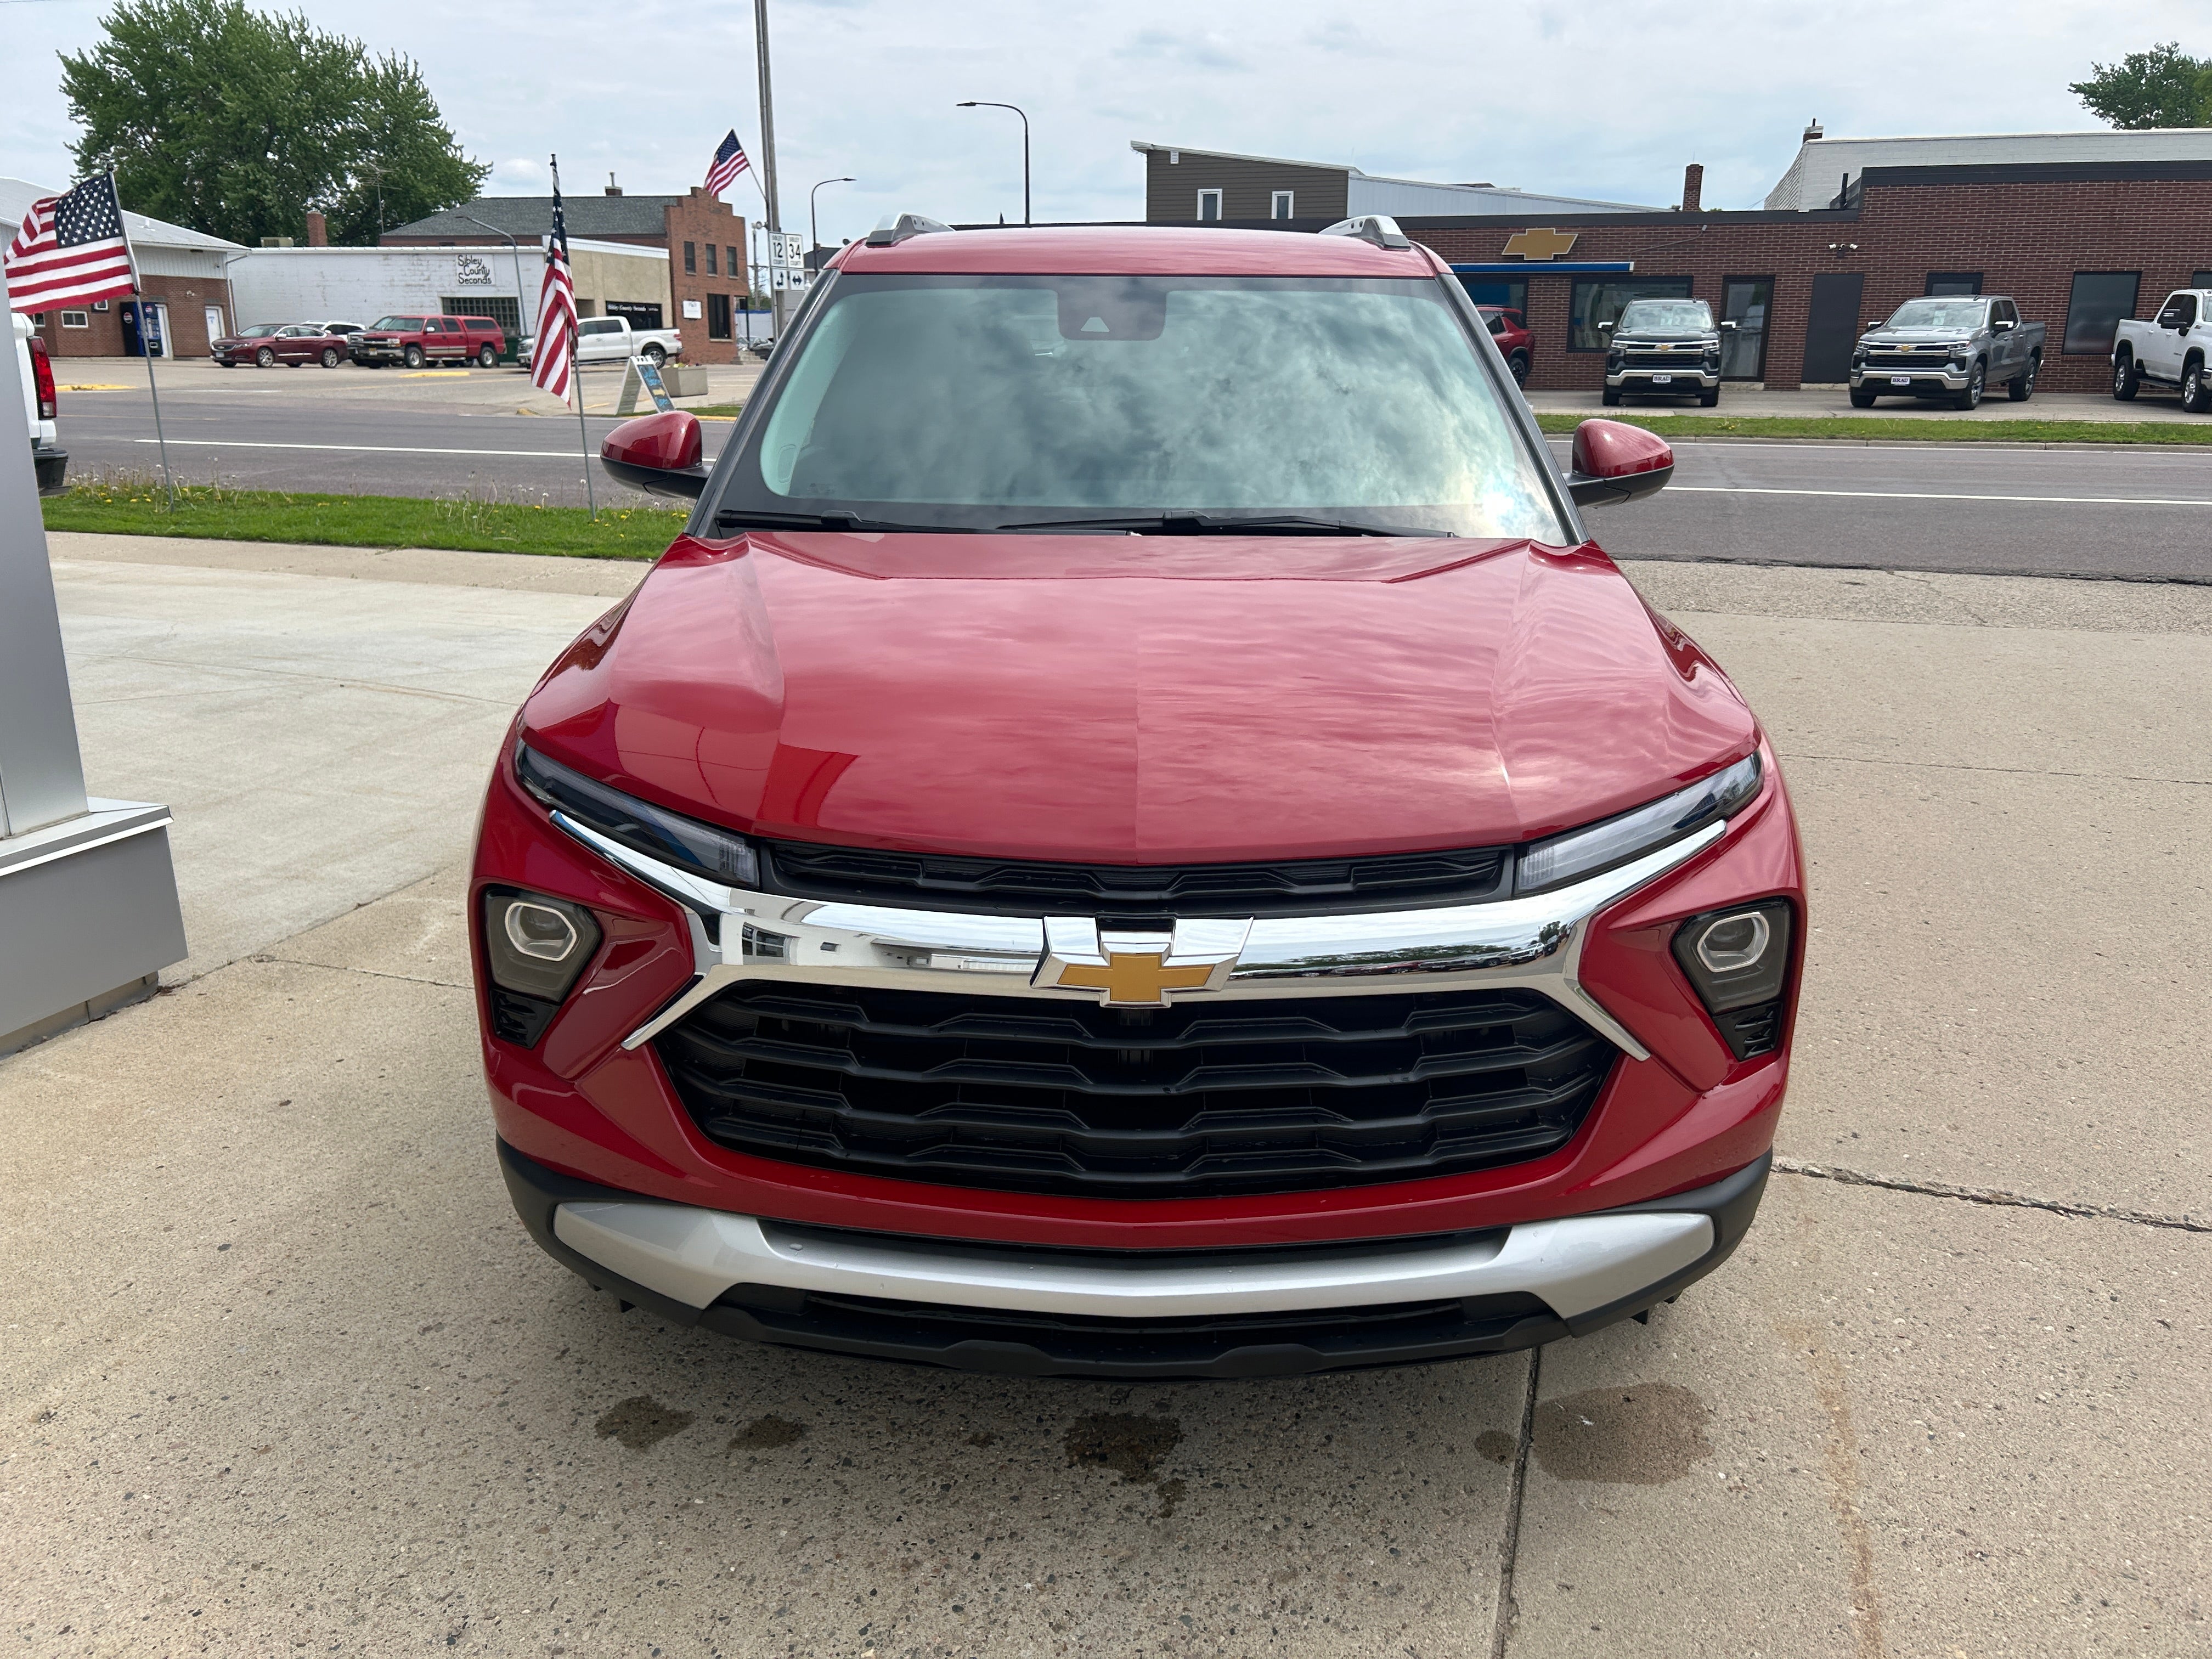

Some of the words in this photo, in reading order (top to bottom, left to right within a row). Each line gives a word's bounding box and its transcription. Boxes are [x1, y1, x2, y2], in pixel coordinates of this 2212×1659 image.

[773, 242, 783, 258] 12
[789, 244, 801, 259] 34
[458, 272, 492, 284] Seconds
[464, 264, 490, 278] County
